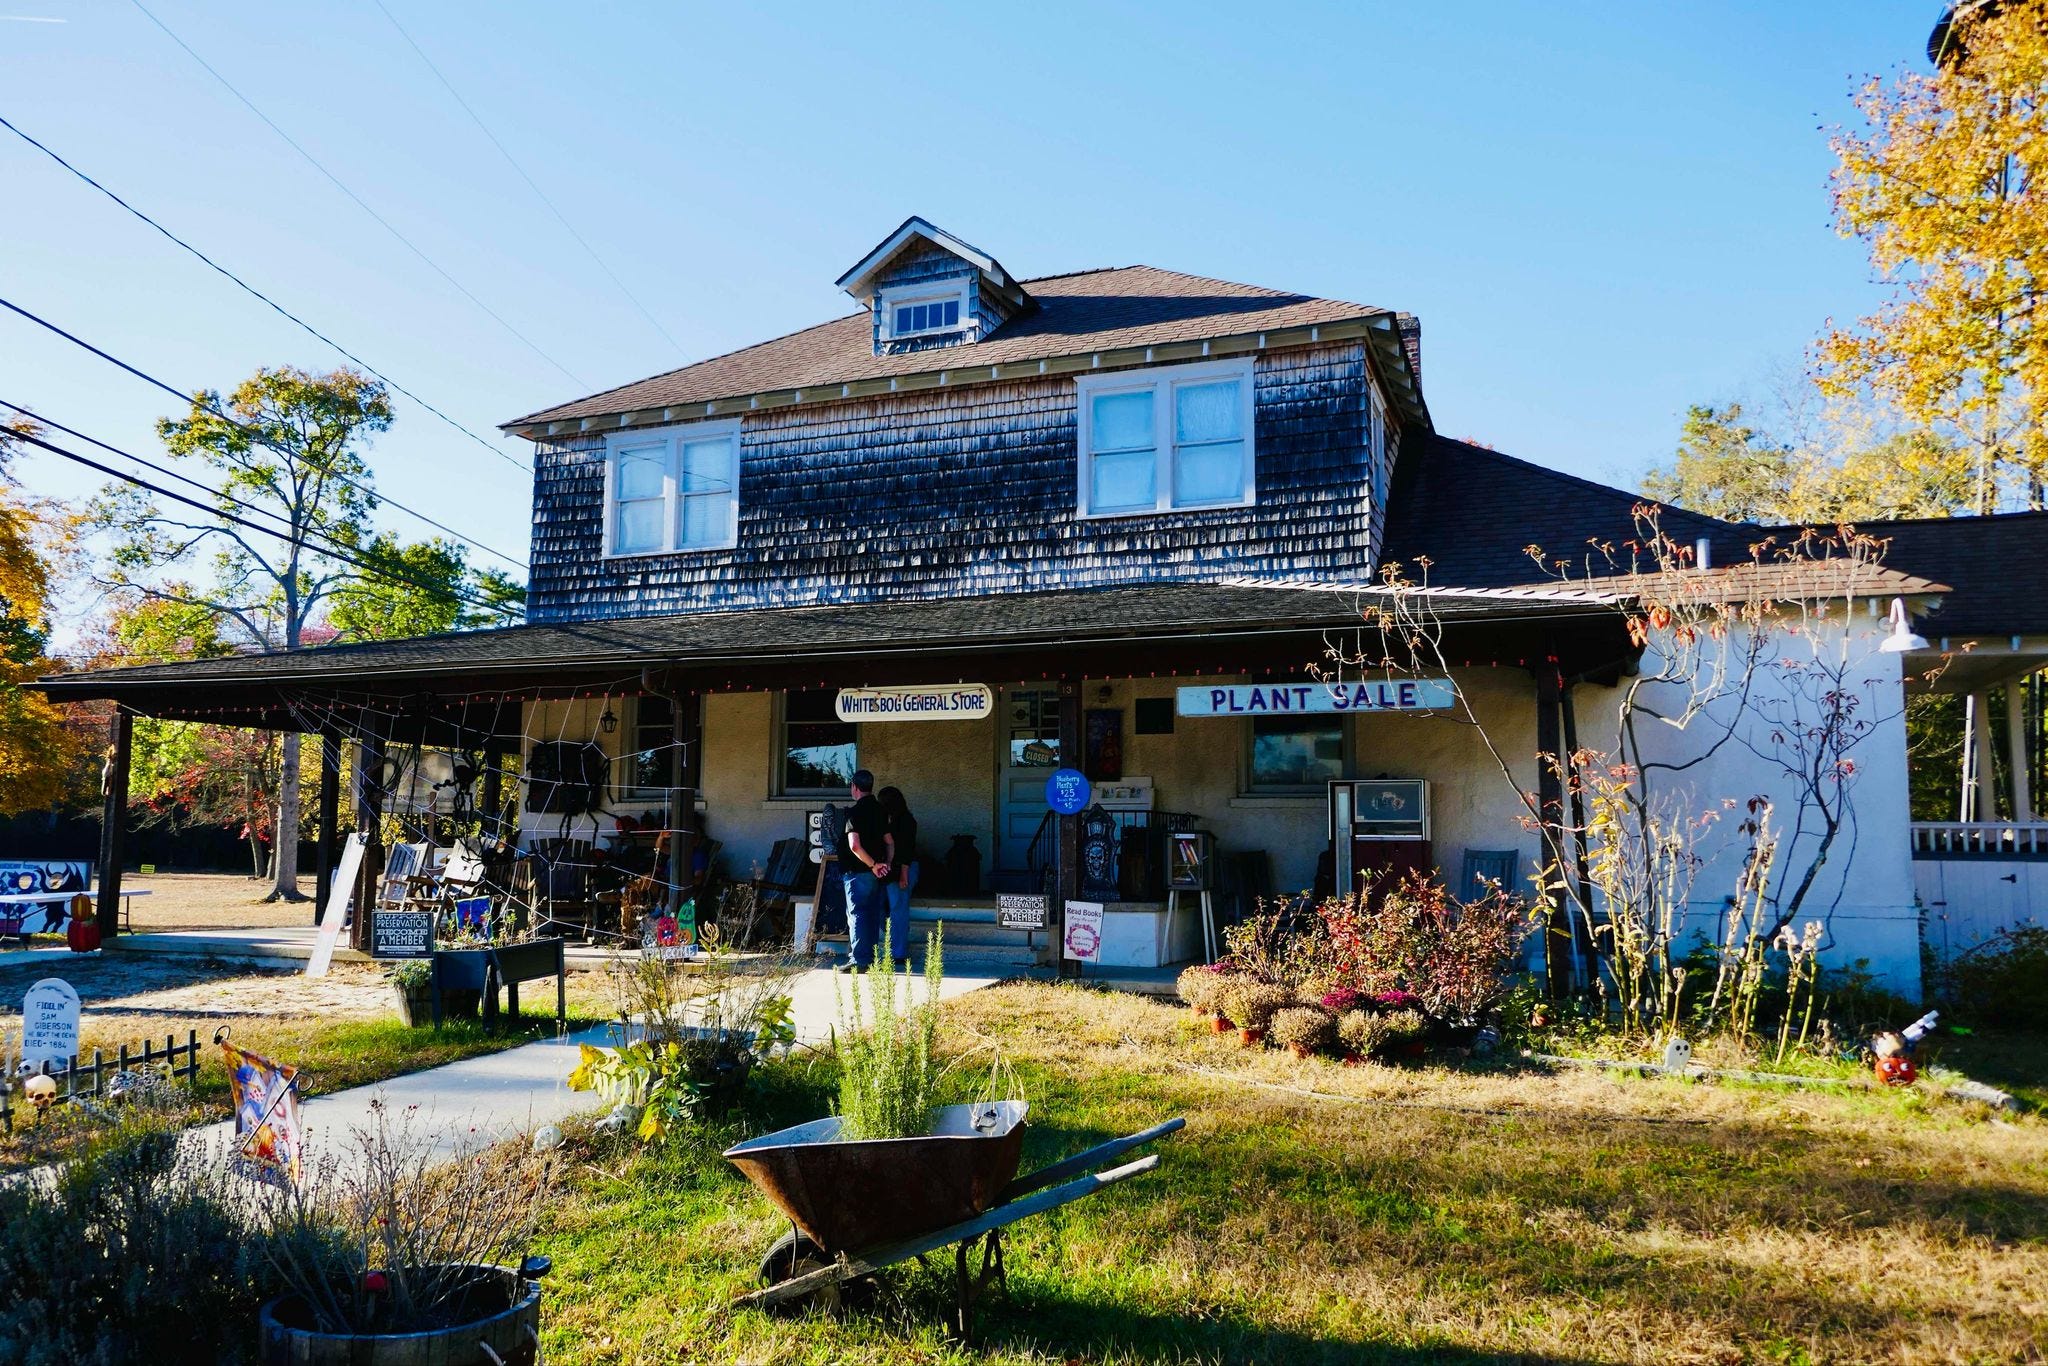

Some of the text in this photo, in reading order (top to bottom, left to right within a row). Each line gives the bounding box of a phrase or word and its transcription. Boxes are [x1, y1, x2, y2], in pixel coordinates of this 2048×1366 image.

[903, 693, 949, 712] GENERAL
[951, 691, 985, 710] STORE
[1210, 682, 1417, 713] PLANT SALE
[1025, 750, 1049, 763] CLOSED
[1061, 788, 1075, 798] $25
[1000, 900, 1044, 909] PRESERVATION
[1003, 912, 1042, 922] A MEMBER
[1066, 907, 1102, 918] Read Books
[376, 919, 429, 928] PRESERVATION
[376, 928, 428, 936] BECOME
[379, 935, 424, 945] A MEMBER
[41, 1012, 57, 1021] SAM
[34, 1022, 73, 1031] GIBERSON
[49, 1041, 67, 1049] 1884
